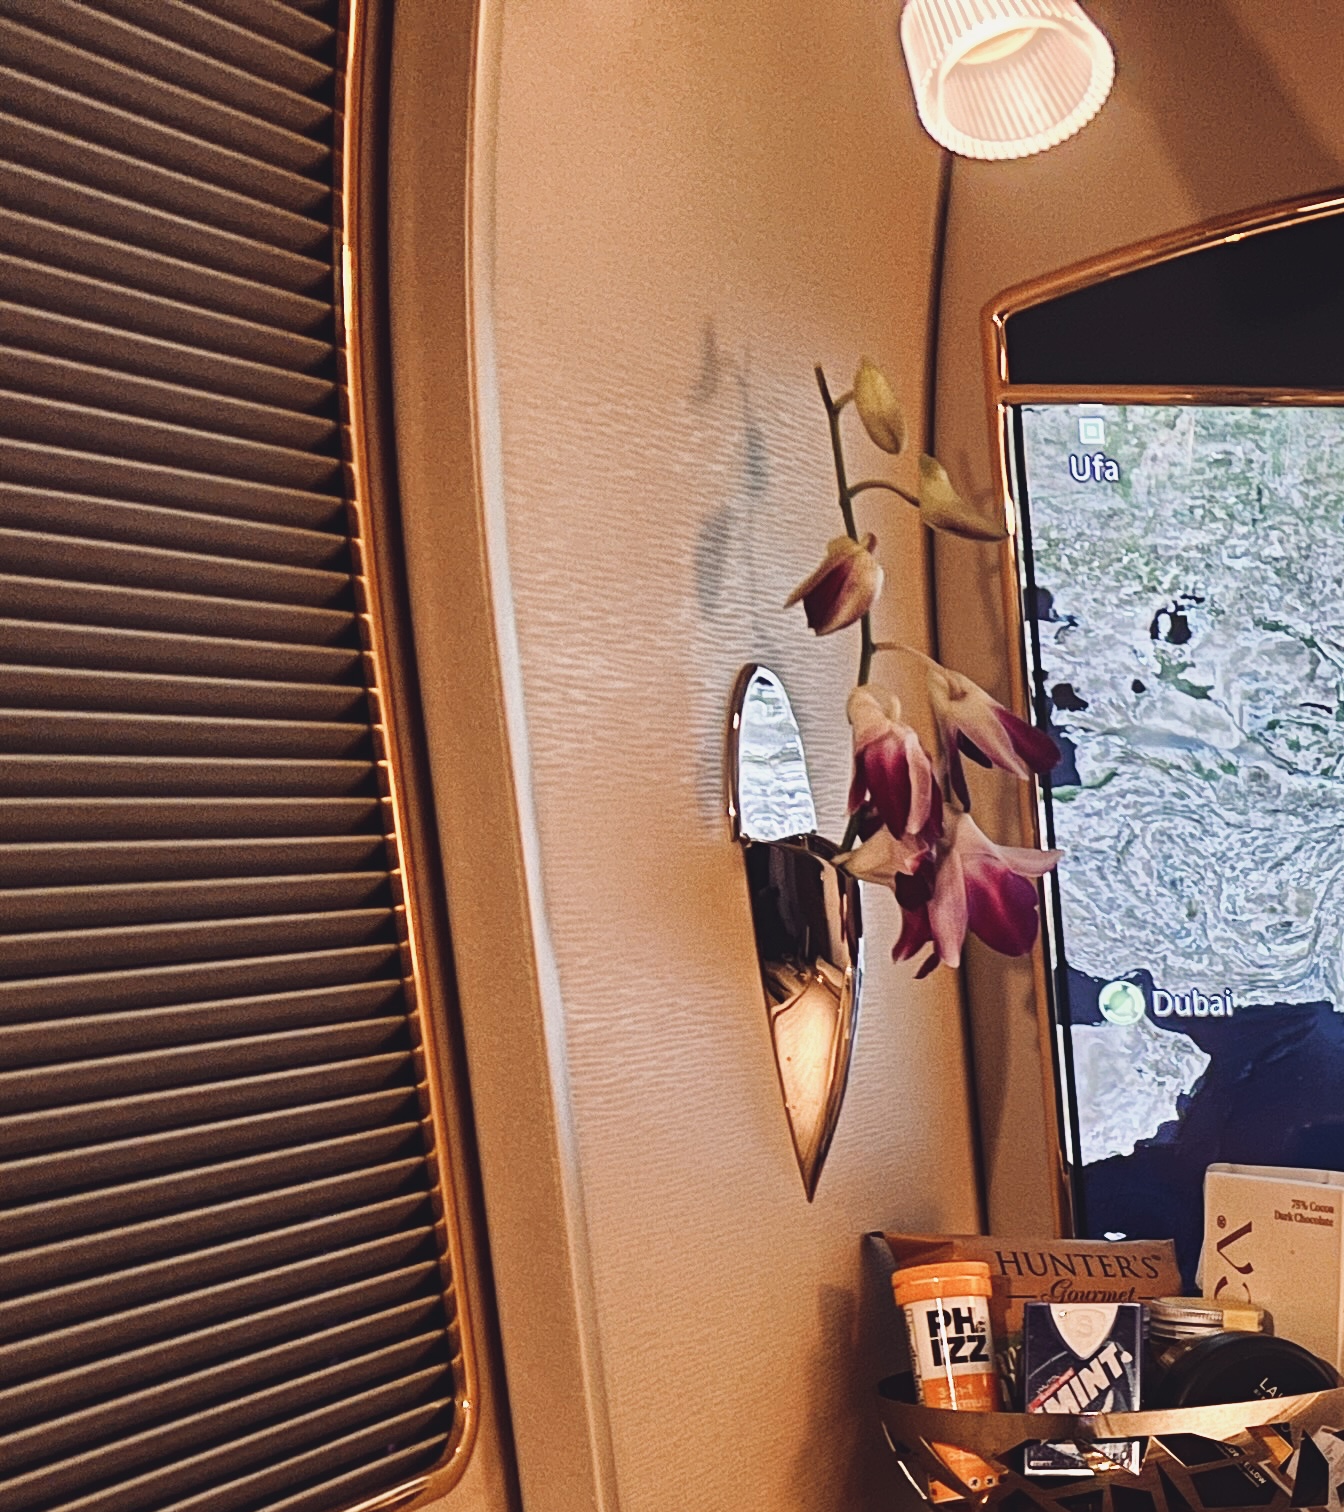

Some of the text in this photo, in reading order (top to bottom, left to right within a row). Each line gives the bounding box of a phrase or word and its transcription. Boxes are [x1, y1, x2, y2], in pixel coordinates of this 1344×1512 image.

[1069, 455, 1119, 483] Ufa
[1153, 990, 1234, 1017] Dubai
[1274, 1210, 1334, 1227] Dark Chocolate
[1310, 1201, 1334, 1214] Cocoa
[995, 1251, 1158, 1278] HUNTER'S
[1041, 1278, 1135, 1302] Gourmet
